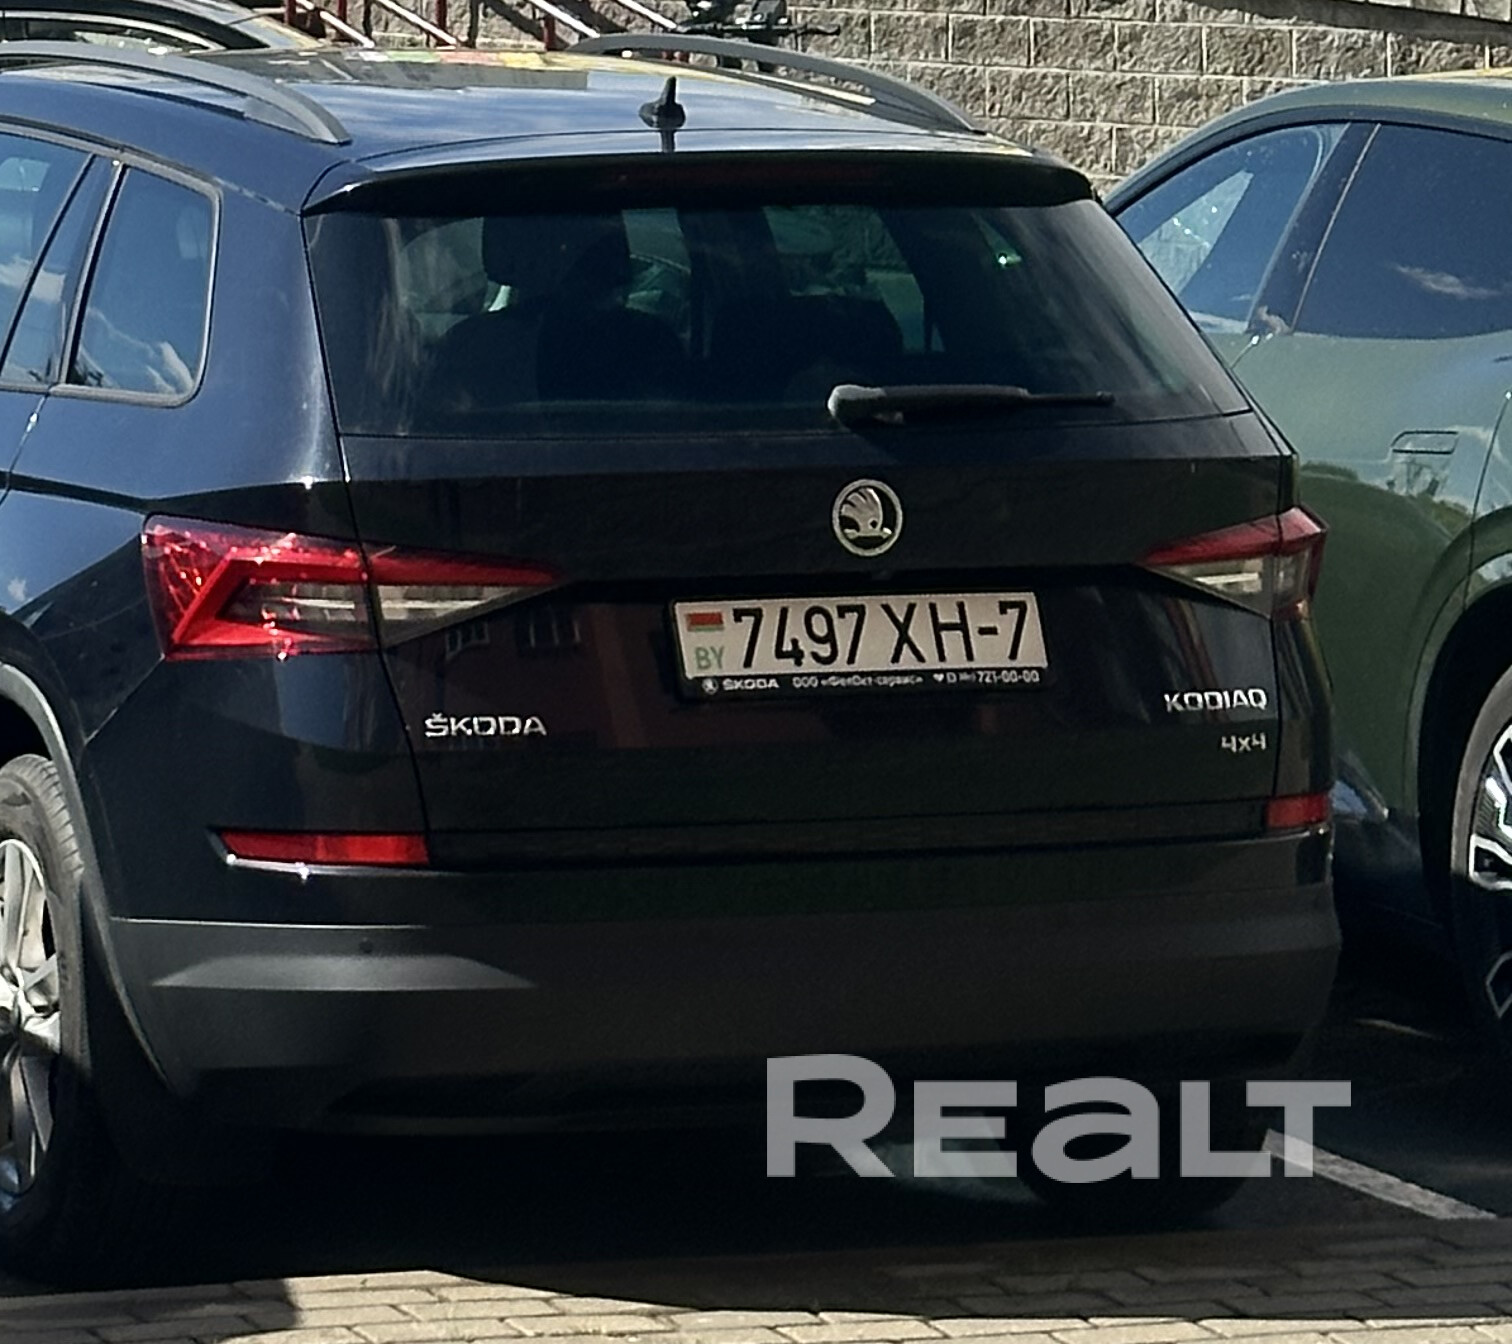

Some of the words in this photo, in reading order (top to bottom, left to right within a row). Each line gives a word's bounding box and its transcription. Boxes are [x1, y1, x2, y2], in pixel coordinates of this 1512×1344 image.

[732, 603, 867, 669] 7497
[694, 645, 725, 670] BY
[1163, 688, 1267, 712] KODIAQ
[424, 712, 548, 738] ŠKODA
